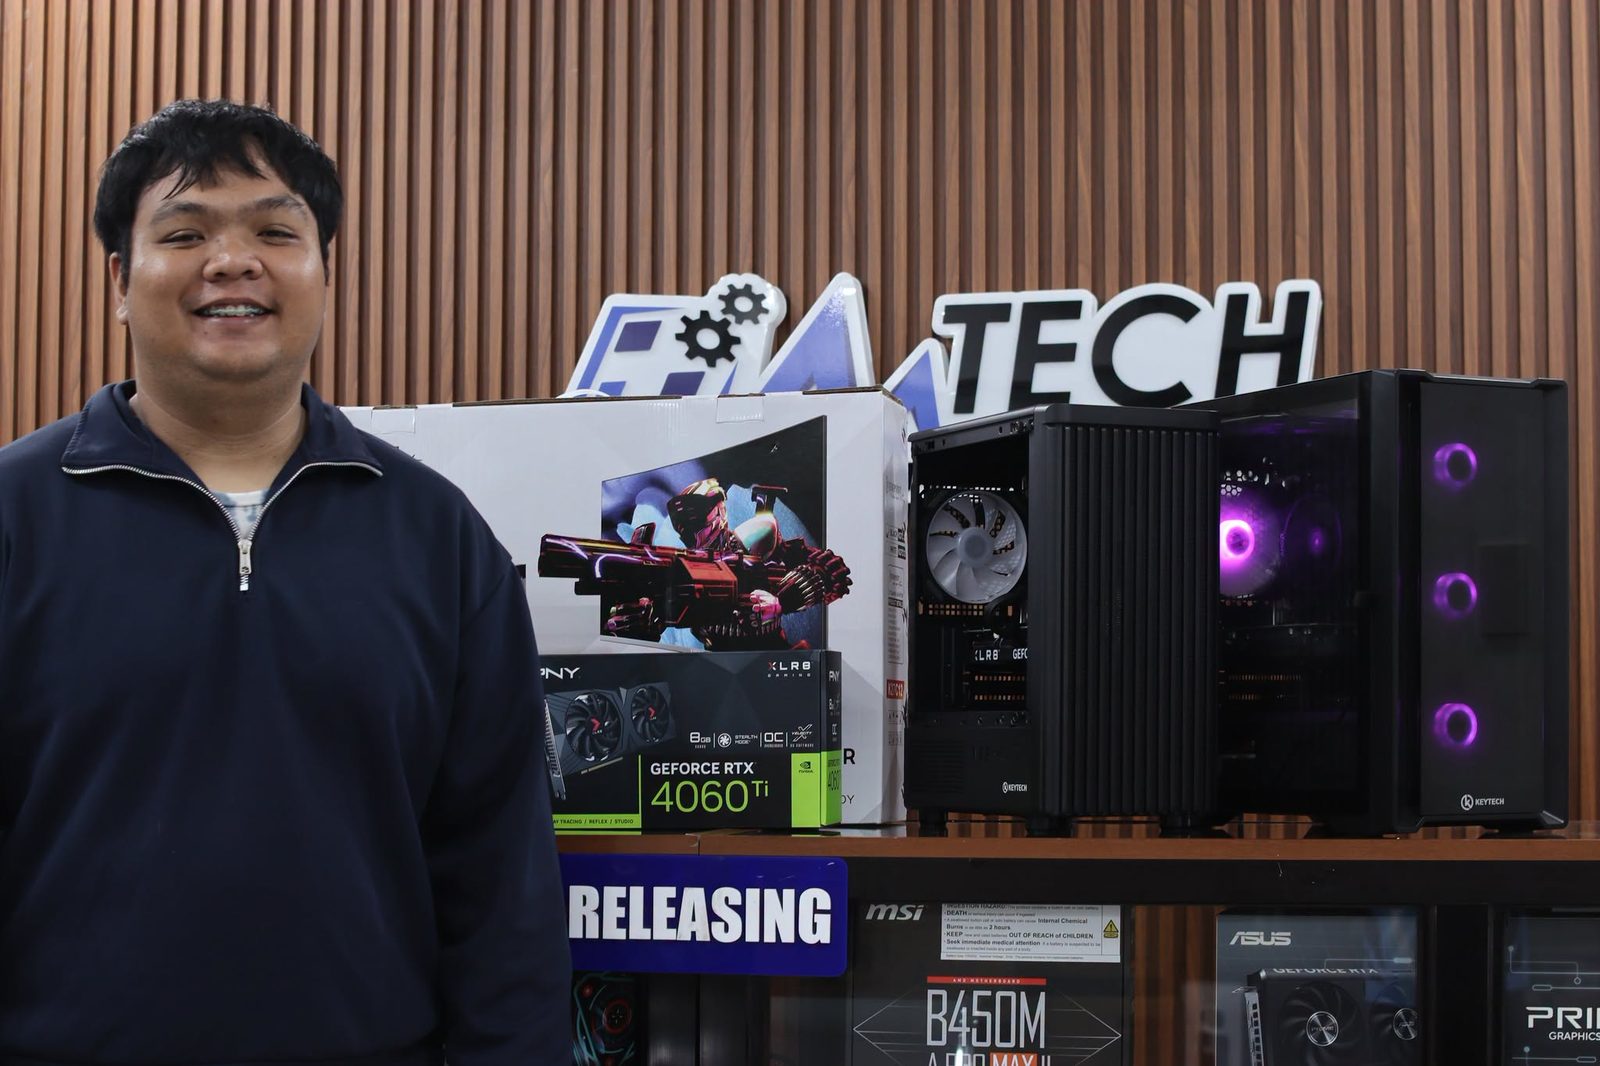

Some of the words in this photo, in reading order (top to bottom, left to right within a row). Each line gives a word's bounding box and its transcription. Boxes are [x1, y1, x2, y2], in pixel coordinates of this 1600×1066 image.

[943, 291, 1311, 414] TECH
[768, 661, 811, 670] XLR8
[764, 732, 784, 742] OC
[650, 762, 720, 775] GEFORCE
[724, 762, 754, 774] RTX
[651, 780, 748, 813] 4060
[1475, 798, 1504, 806] KEYTECH
[568, 885, 832, 944] RELEASING
[866, 904, 924, 920] msi
[1230, 931, 1291, 946] ASUS
[927, 989, 1046, 1048] B450M
